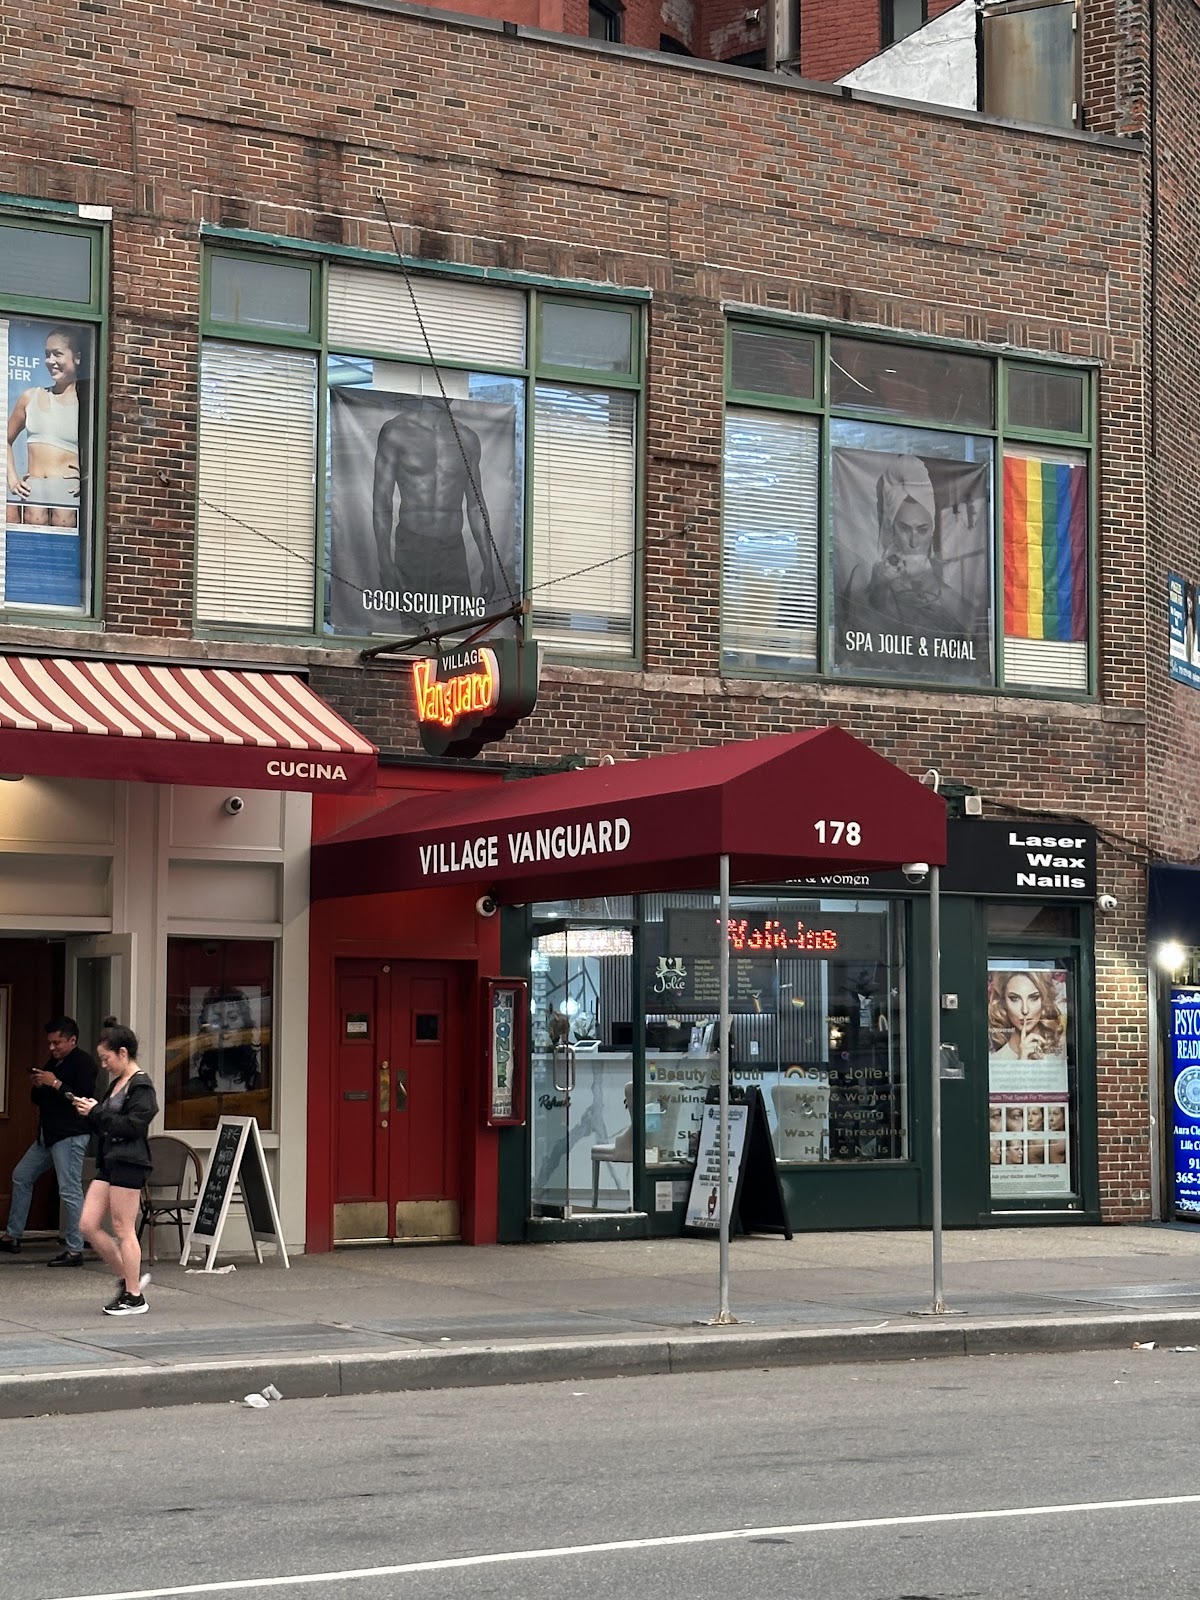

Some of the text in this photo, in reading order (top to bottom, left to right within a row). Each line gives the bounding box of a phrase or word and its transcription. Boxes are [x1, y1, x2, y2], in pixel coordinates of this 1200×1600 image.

[8, 355, 40, 369] SELF
[362, 589, 486, 618] COOLSCULPTING
[845, 631, 976, 661] SPA JOLIE & FACIAL
[413, 648, 493, 726] Vanguard
[266, 760, 348, 781] CUCINA
[813, 820, 862, 847] 178
[1008, 832, 1087, 849] Laser
[419, 817, 631, 875] VILLAGE VANGUARD
[1026, 853, 1086, 869] Wax
[1016, 872, 1086, 889] Nails
[657, 1067, 706, 1083] Beauty
[808, 1067, 839, 1082] Spa
[845, 1092, 897, 1102] Women
[784, 1128, 816, 1138] Wax
